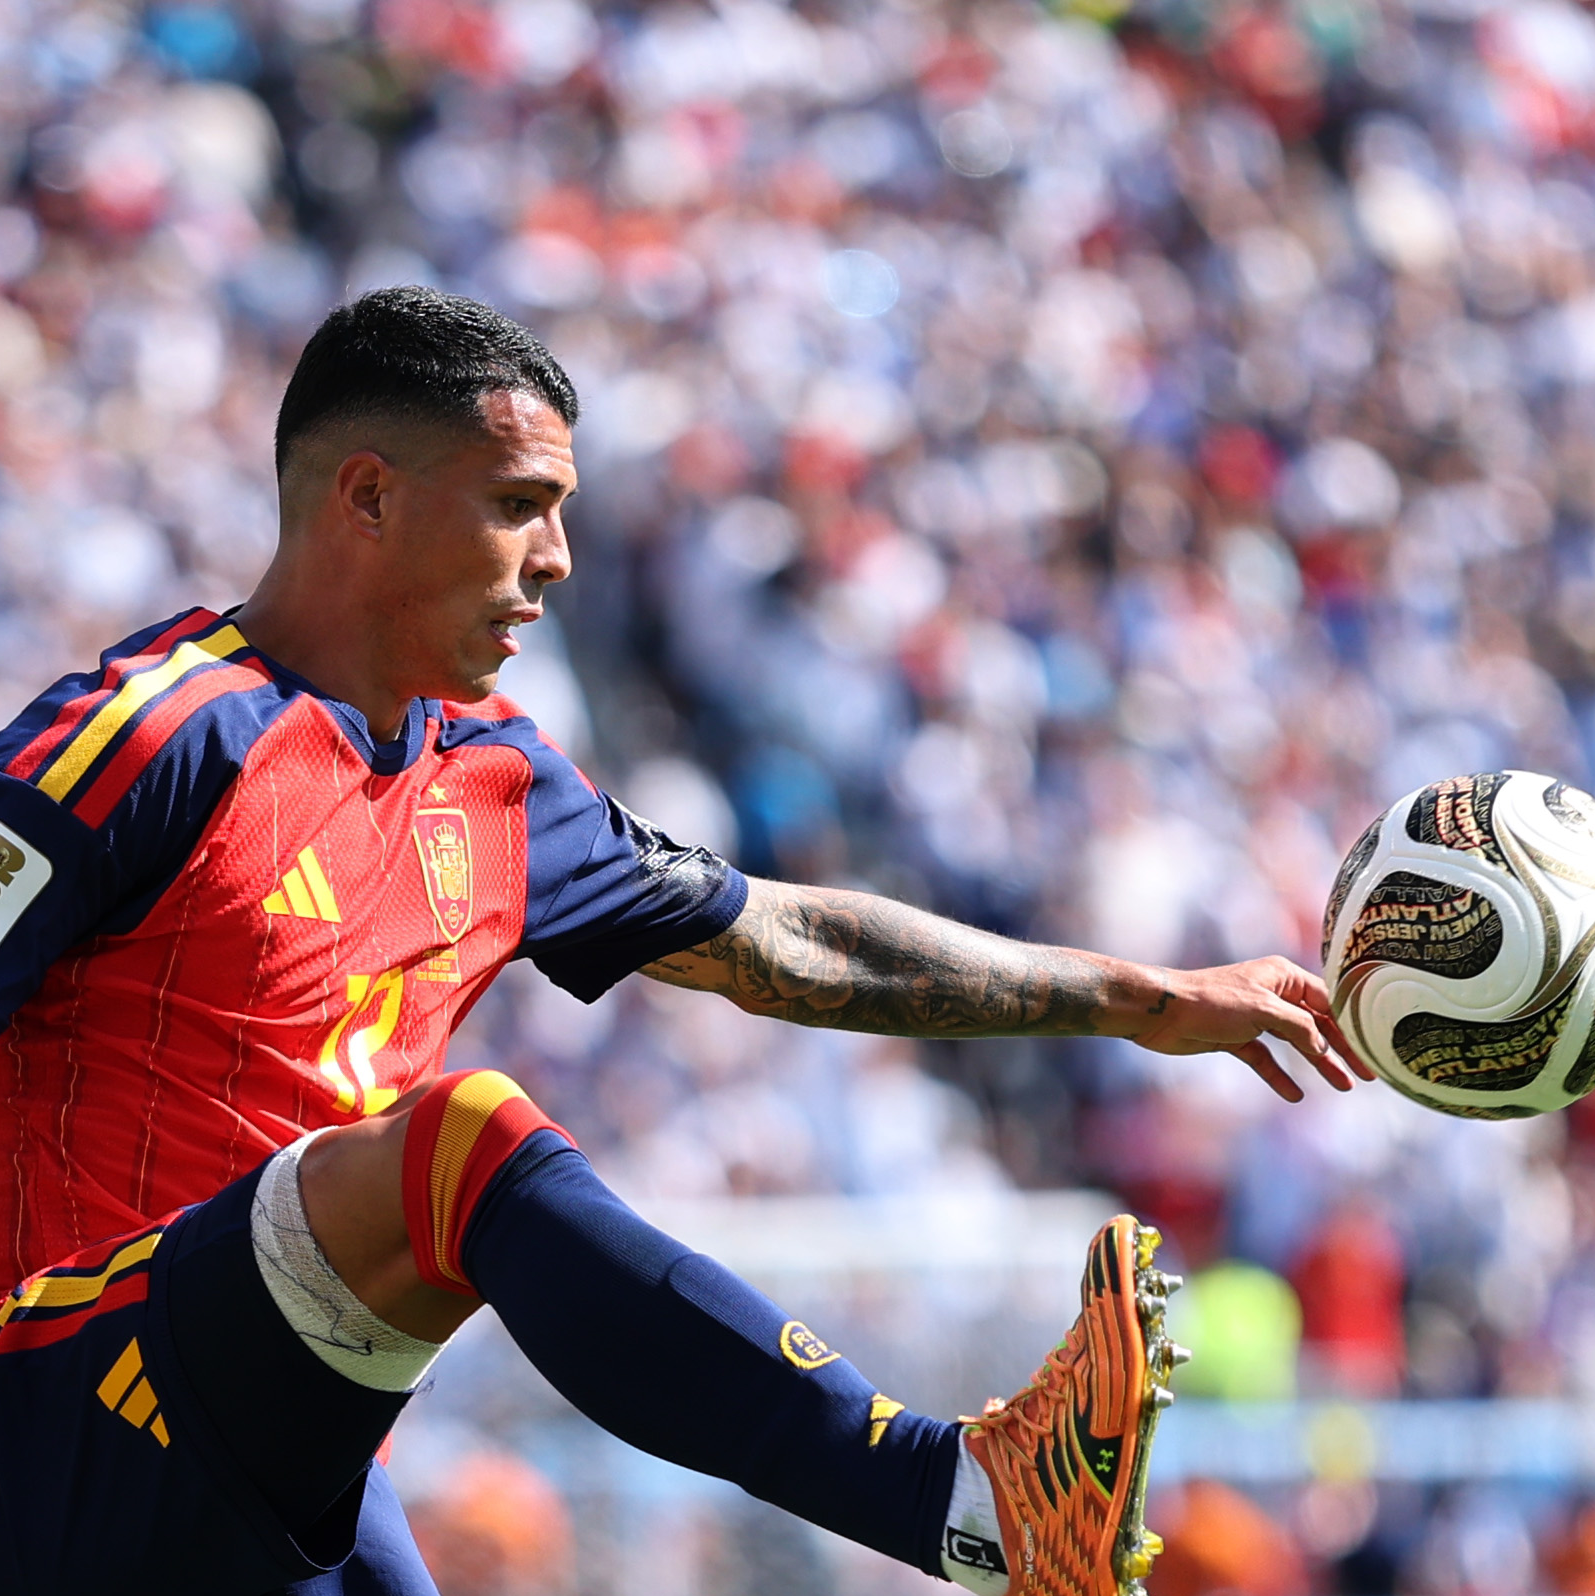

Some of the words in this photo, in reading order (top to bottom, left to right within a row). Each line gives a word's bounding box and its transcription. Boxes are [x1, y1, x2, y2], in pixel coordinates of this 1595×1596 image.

[1436, 795, 1477, 849] JERSEY
[1455, 793, 1493, 846] YORK
[1355, 889, 1474, 932] ATLANTA
[1430, 911, 1480, 941] NEW
[1357, 923, 1427, 958] JERSEY
[1416, 1046, 1462, 1068] NEW
[1466, 1015, 1547, 1058] JERSEY
[1428, 1034, 1560, 1084] ATLANTA
